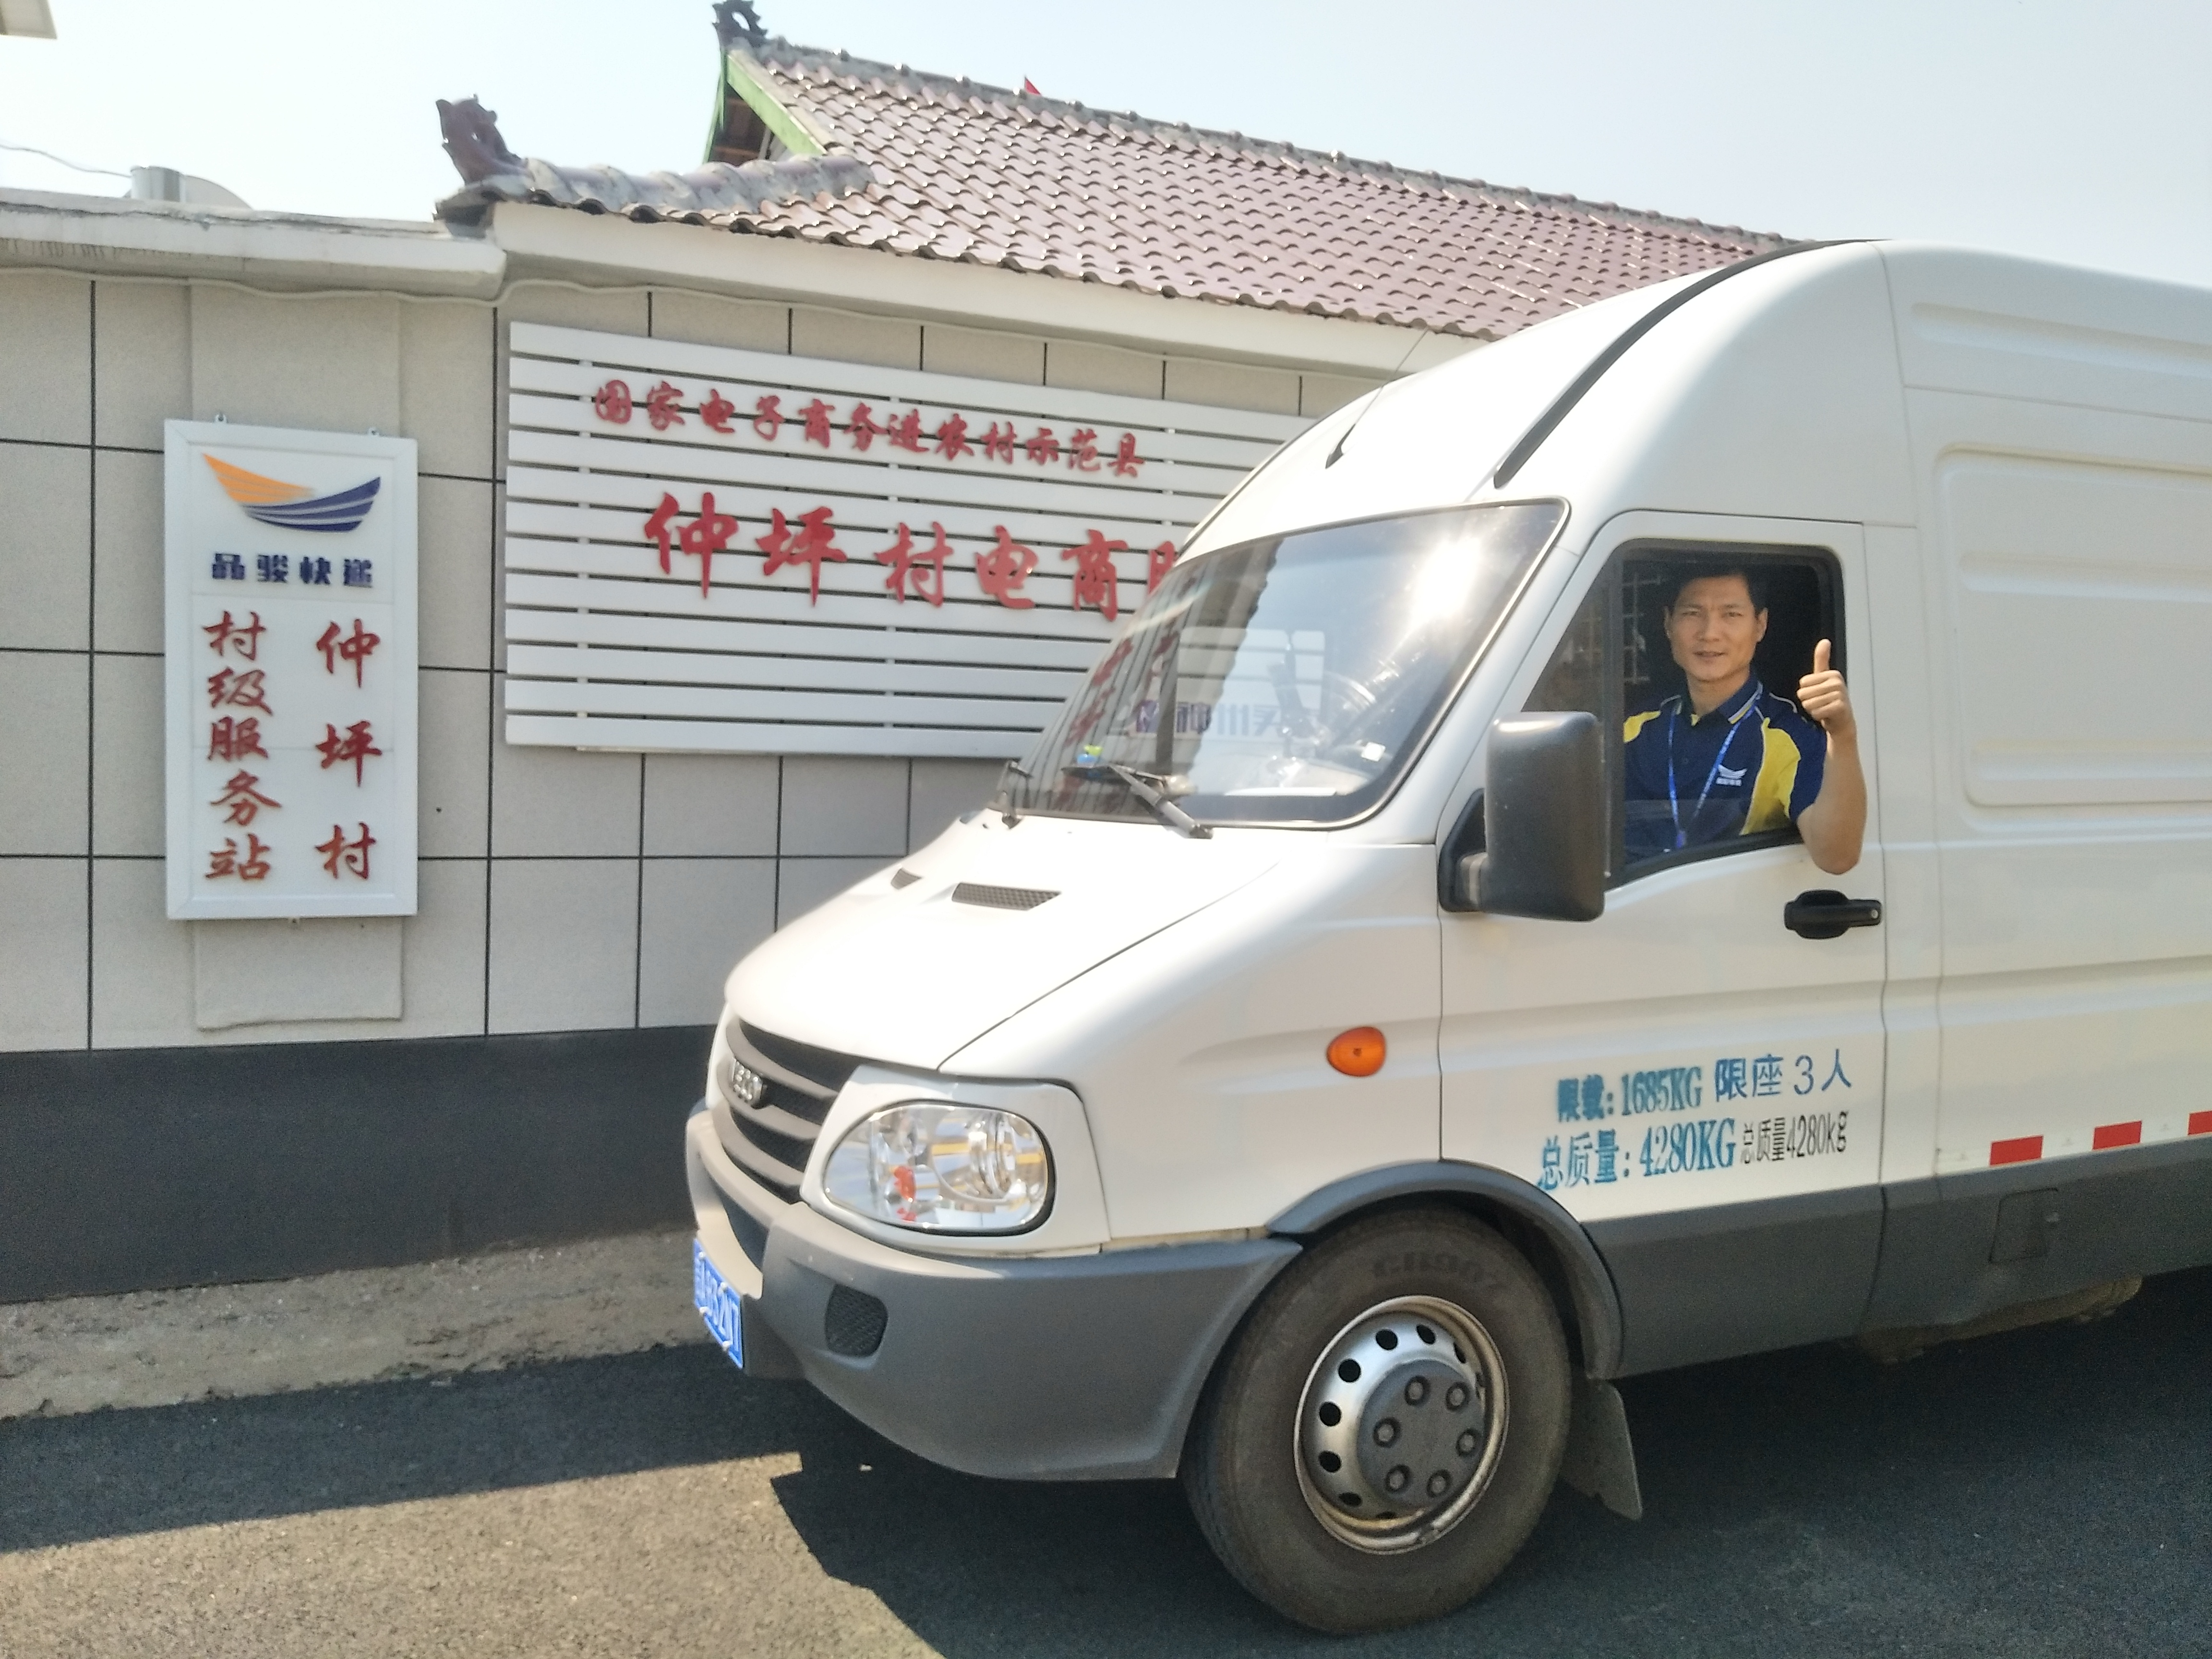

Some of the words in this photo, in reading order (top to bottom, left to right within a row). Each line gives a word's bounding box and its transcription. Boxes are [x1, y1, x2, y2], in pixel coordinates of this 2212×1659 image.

[594, 378, 1145, 479] 国家电子商务进农村示范县
[212, 553, 373, 588] 品骏快递
[202, 611, 281, 881] 村级服务站
[316, 619, 382, 879] 仲坪村
